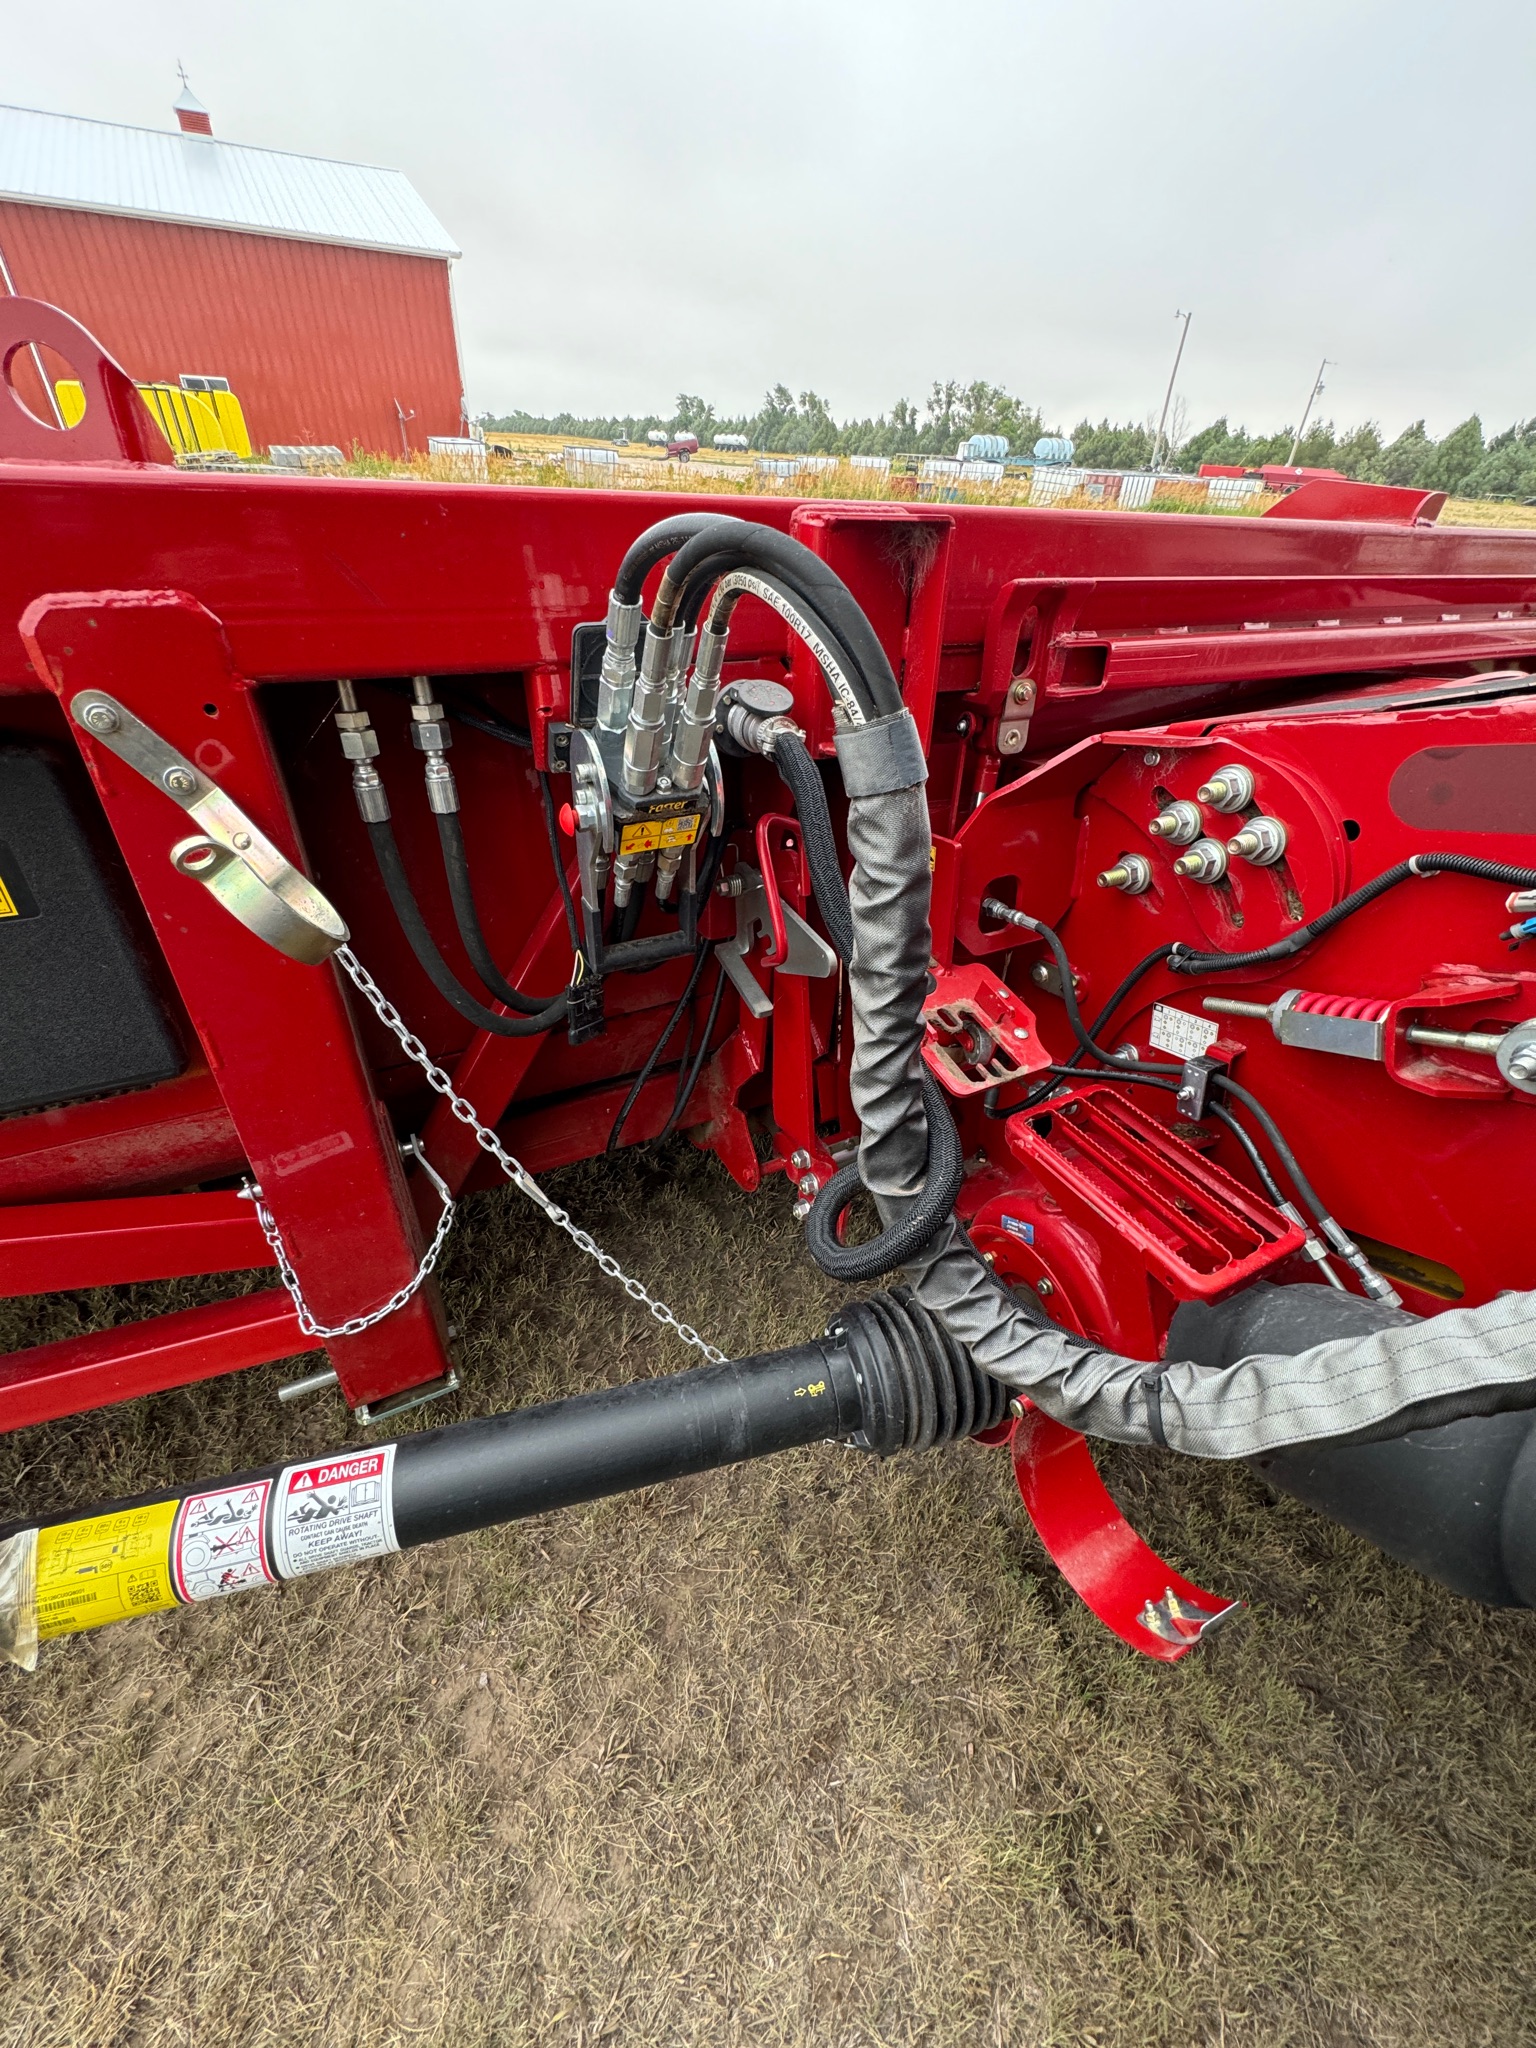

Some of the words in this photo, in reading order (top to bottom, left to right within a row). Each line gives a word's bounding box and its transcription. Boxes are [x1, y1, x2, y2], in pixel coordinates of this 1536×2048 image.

[763, 588, 780, 607] SAE
[780, 604, 811, 640] 100R17
[812, 642, 840, 681] MSHA
[318, 1458, 379, 1484] DANGER
[288, 1521, 327, 1536] ROTATING
[329, 1516, 352, 1527] DRIVE
[354, 1510, 378, 1522] SHAFT
[300, 1531, 323, 1541] CONTACT
[335, 1524, 351, 1533] CAUSE
[352, 1521, 368, 1529] DEATH
[304, 1548, 317, 1556] NOT
[318, 1541, 348, 1552] OPERATE
[308, 1537, 333, 1548] KEEP
[334, 1529, 363, 1542] AWAY!
